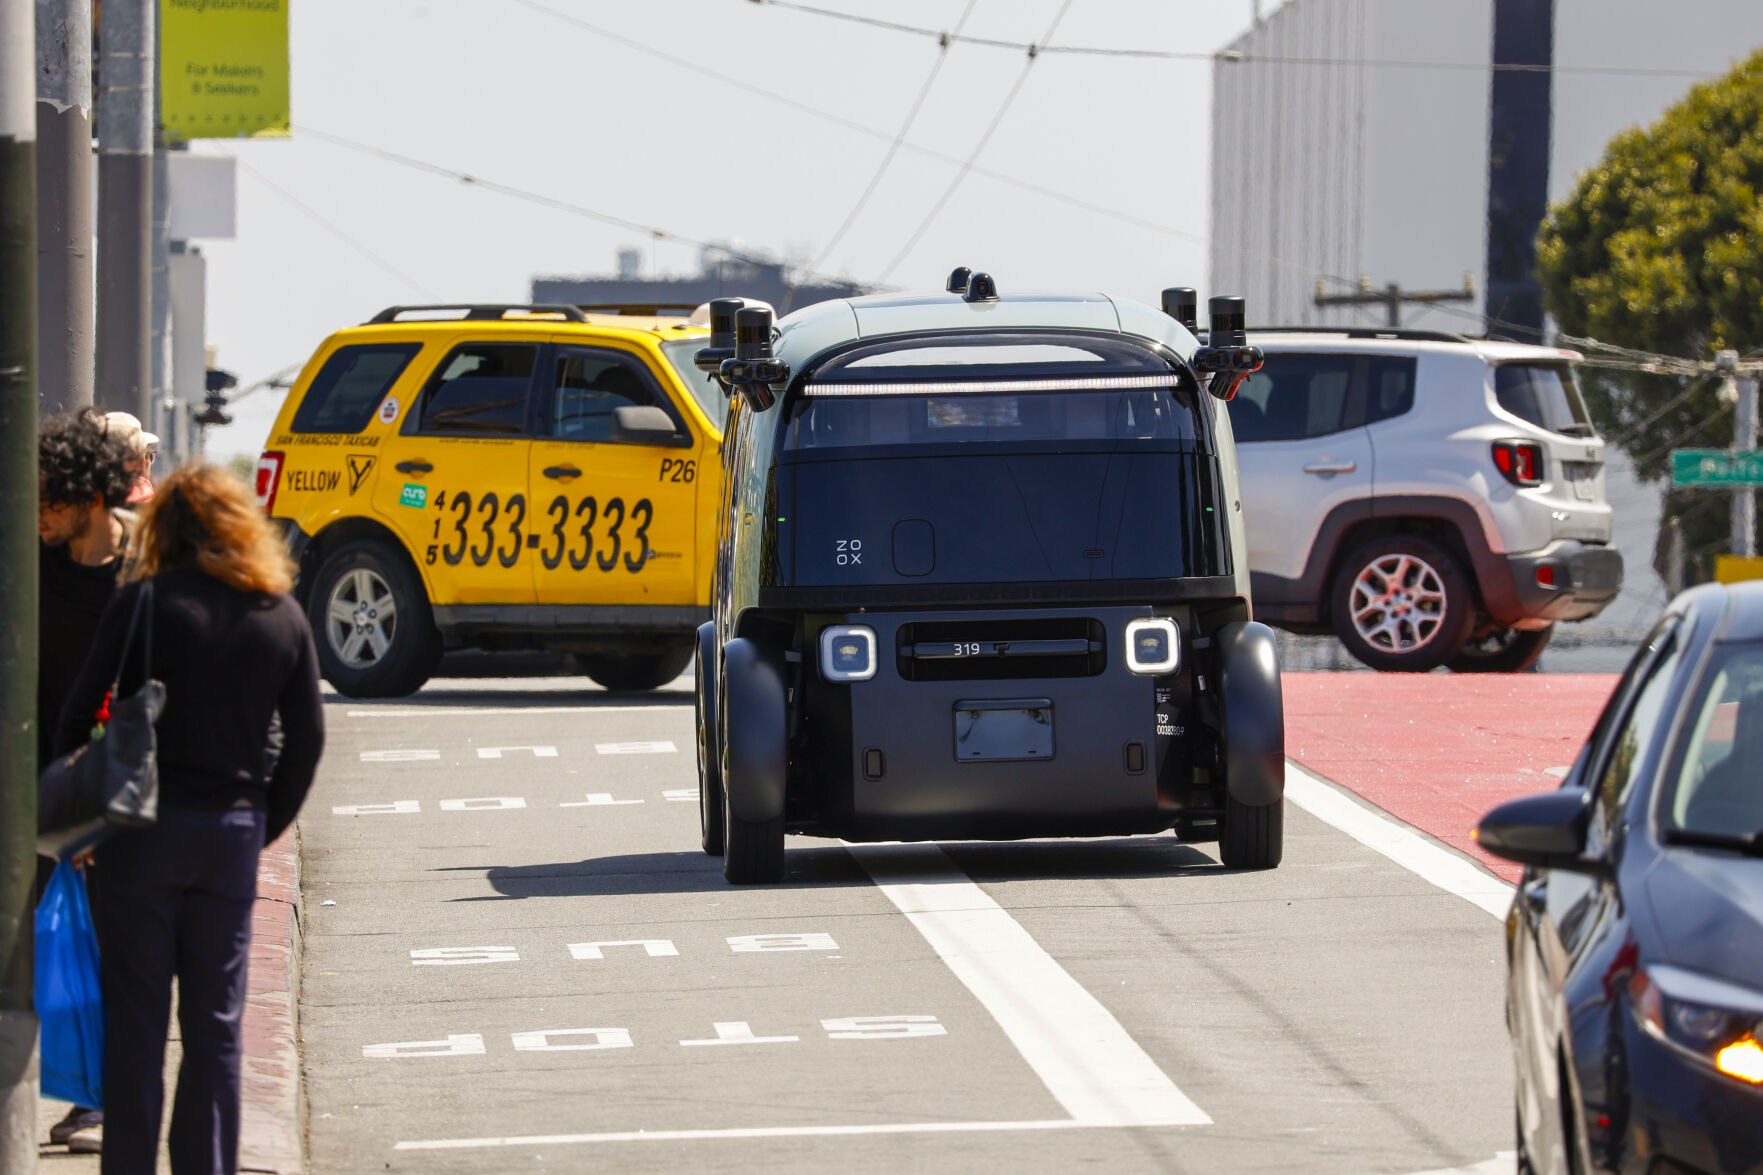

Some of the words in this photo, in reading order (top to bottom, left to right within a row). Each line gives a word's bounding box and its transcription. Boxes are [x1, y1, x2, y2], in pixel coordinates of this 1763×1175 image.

[186, 63, 208, 76] For
[213, 65, 264, 79] Makers
[206, 82, 260, 97] Seekers
[275, 435, 293, 446] SAN
[296, 435, 341, 446] FRANCISCO
[343, 435, 380, 447] TAXICAB
[659, 458, 696, 483] P26
[286, 470, 341, 492] YELLOW
[443, 491, 653, 574] 333-3333
[953, 643, 980, 656] 319
[1156, 713, 1169, 724] TCP
[410, 932, 841, 966] BUS
[362, 1015, 948, 1058] STOP
